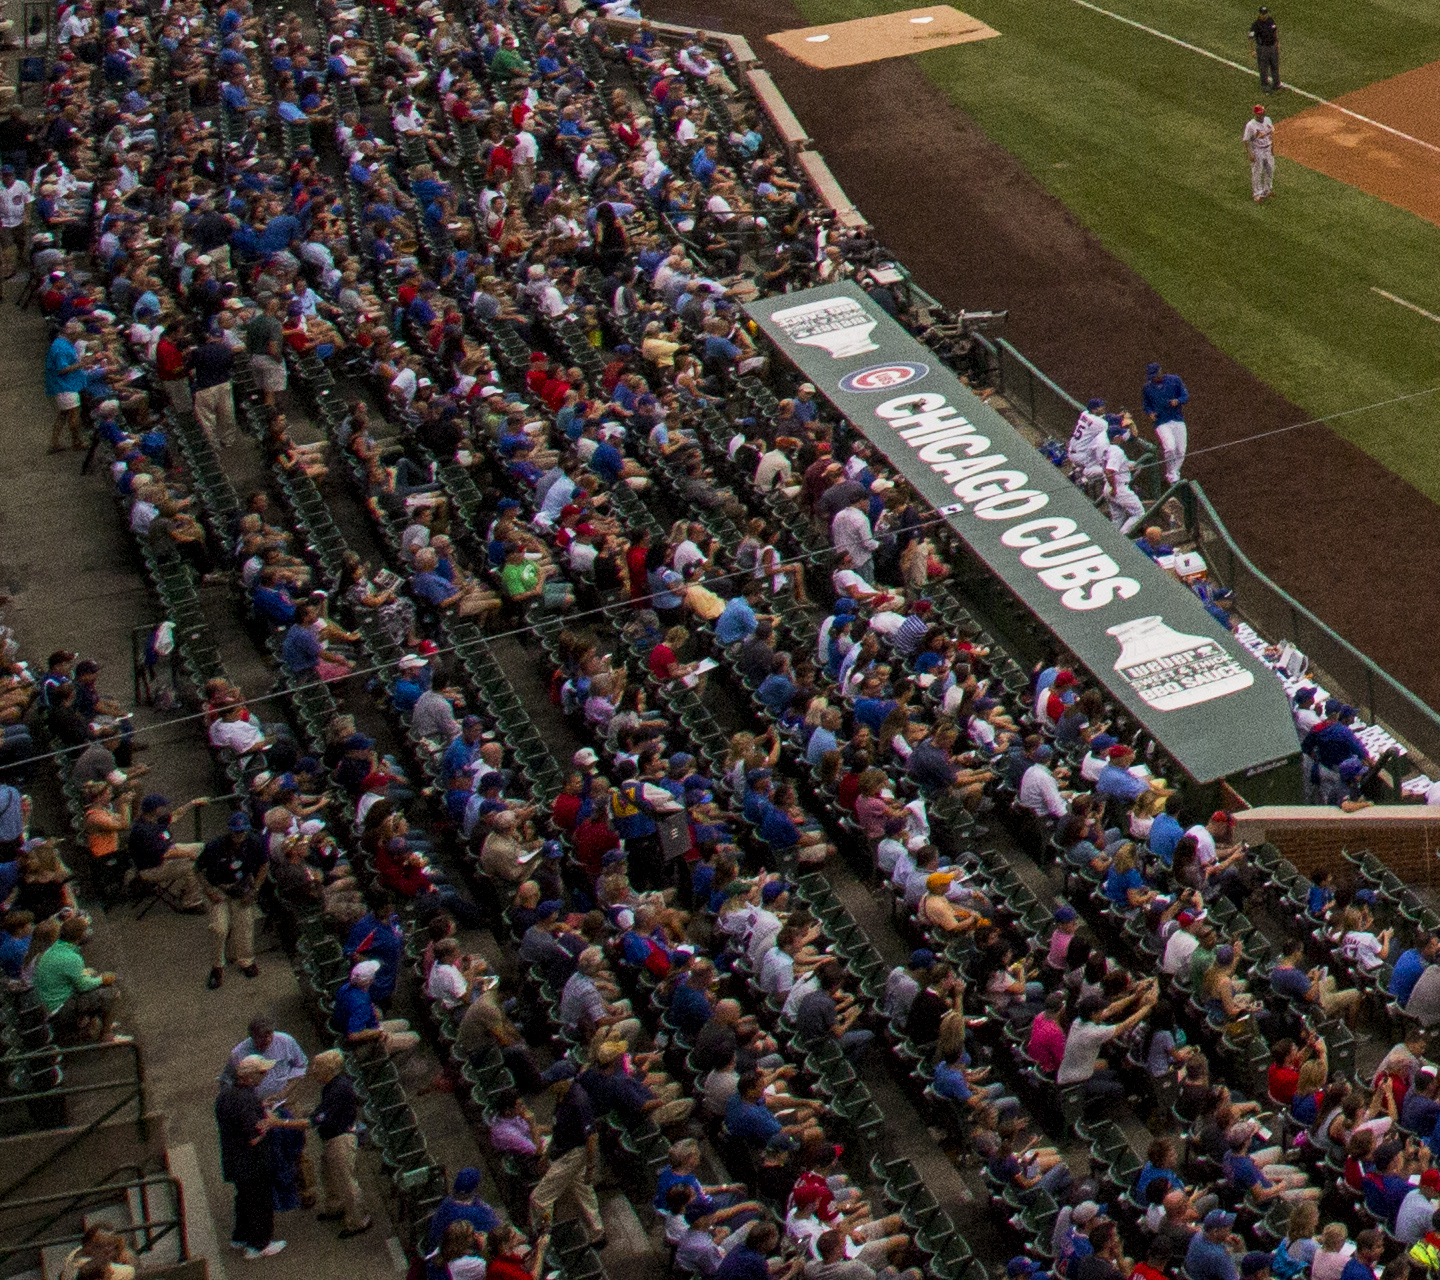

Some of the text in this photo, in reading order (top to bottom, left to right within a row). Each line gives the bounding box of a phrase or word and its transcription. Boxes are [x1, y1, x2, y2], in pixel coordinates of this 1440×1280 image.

[875, 393, 1141, 610] CHICAGO CUBS
[1126, 649, 1196, 679] weber
[1181, 662, 1246, 690] SAUCE
